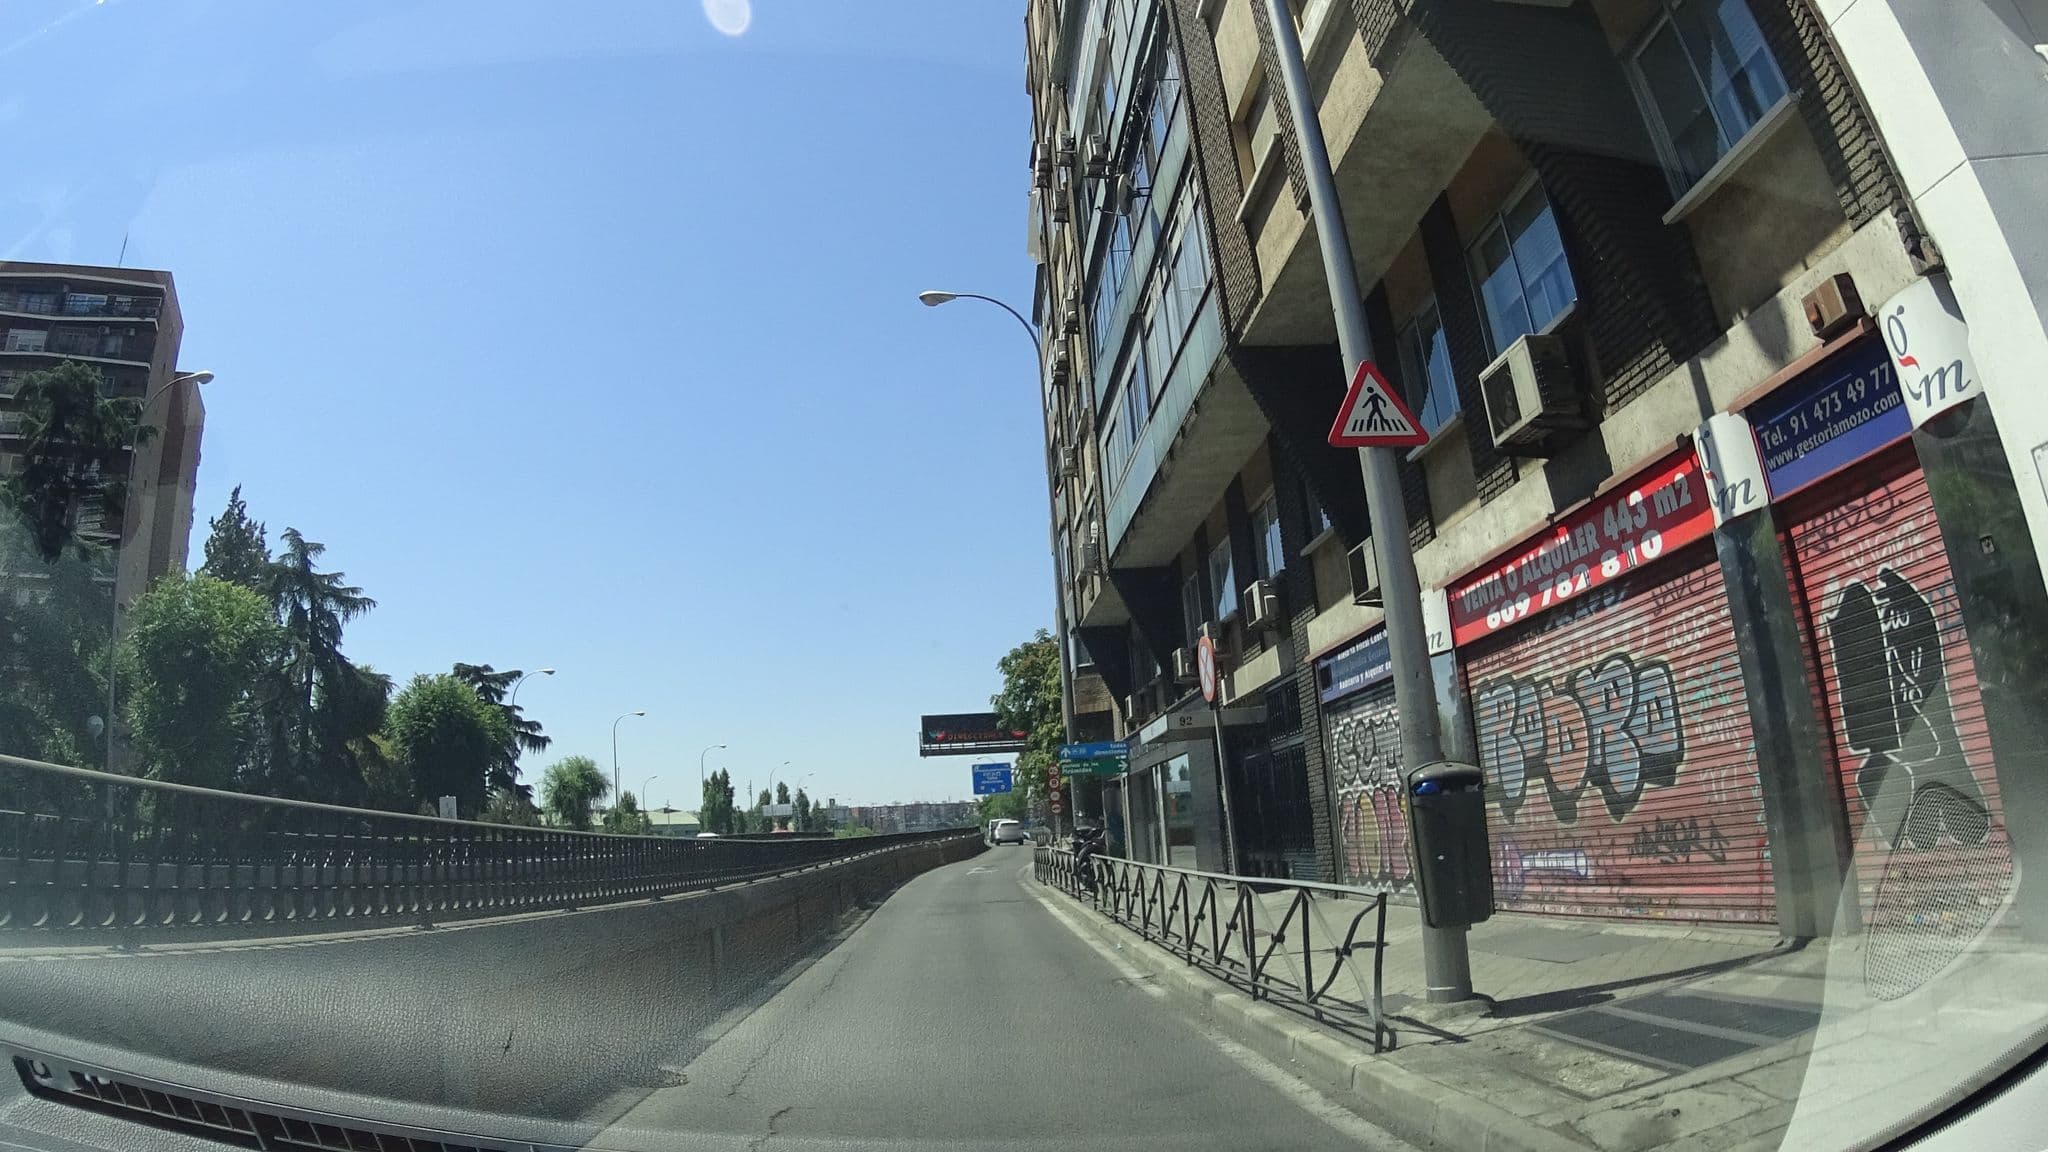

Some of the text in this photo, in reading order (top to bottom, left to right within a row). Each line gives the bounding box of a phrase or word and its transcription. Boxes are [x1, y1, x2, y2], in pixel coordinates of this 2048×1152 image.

[1761, 361, 1891, 450] Tel. 91 473 49 77
[1766, 390, 1901, 472] www.gestoriamozo.com
[1461, 570, 1505, 613] VENTA
[1506, 565, 1518, 592] O
[1522, 521, 1600, 586] ALQUILER
[1603, 490, 1648, 541] 443
[1486, 529, 1663, 629] 609 782 810
